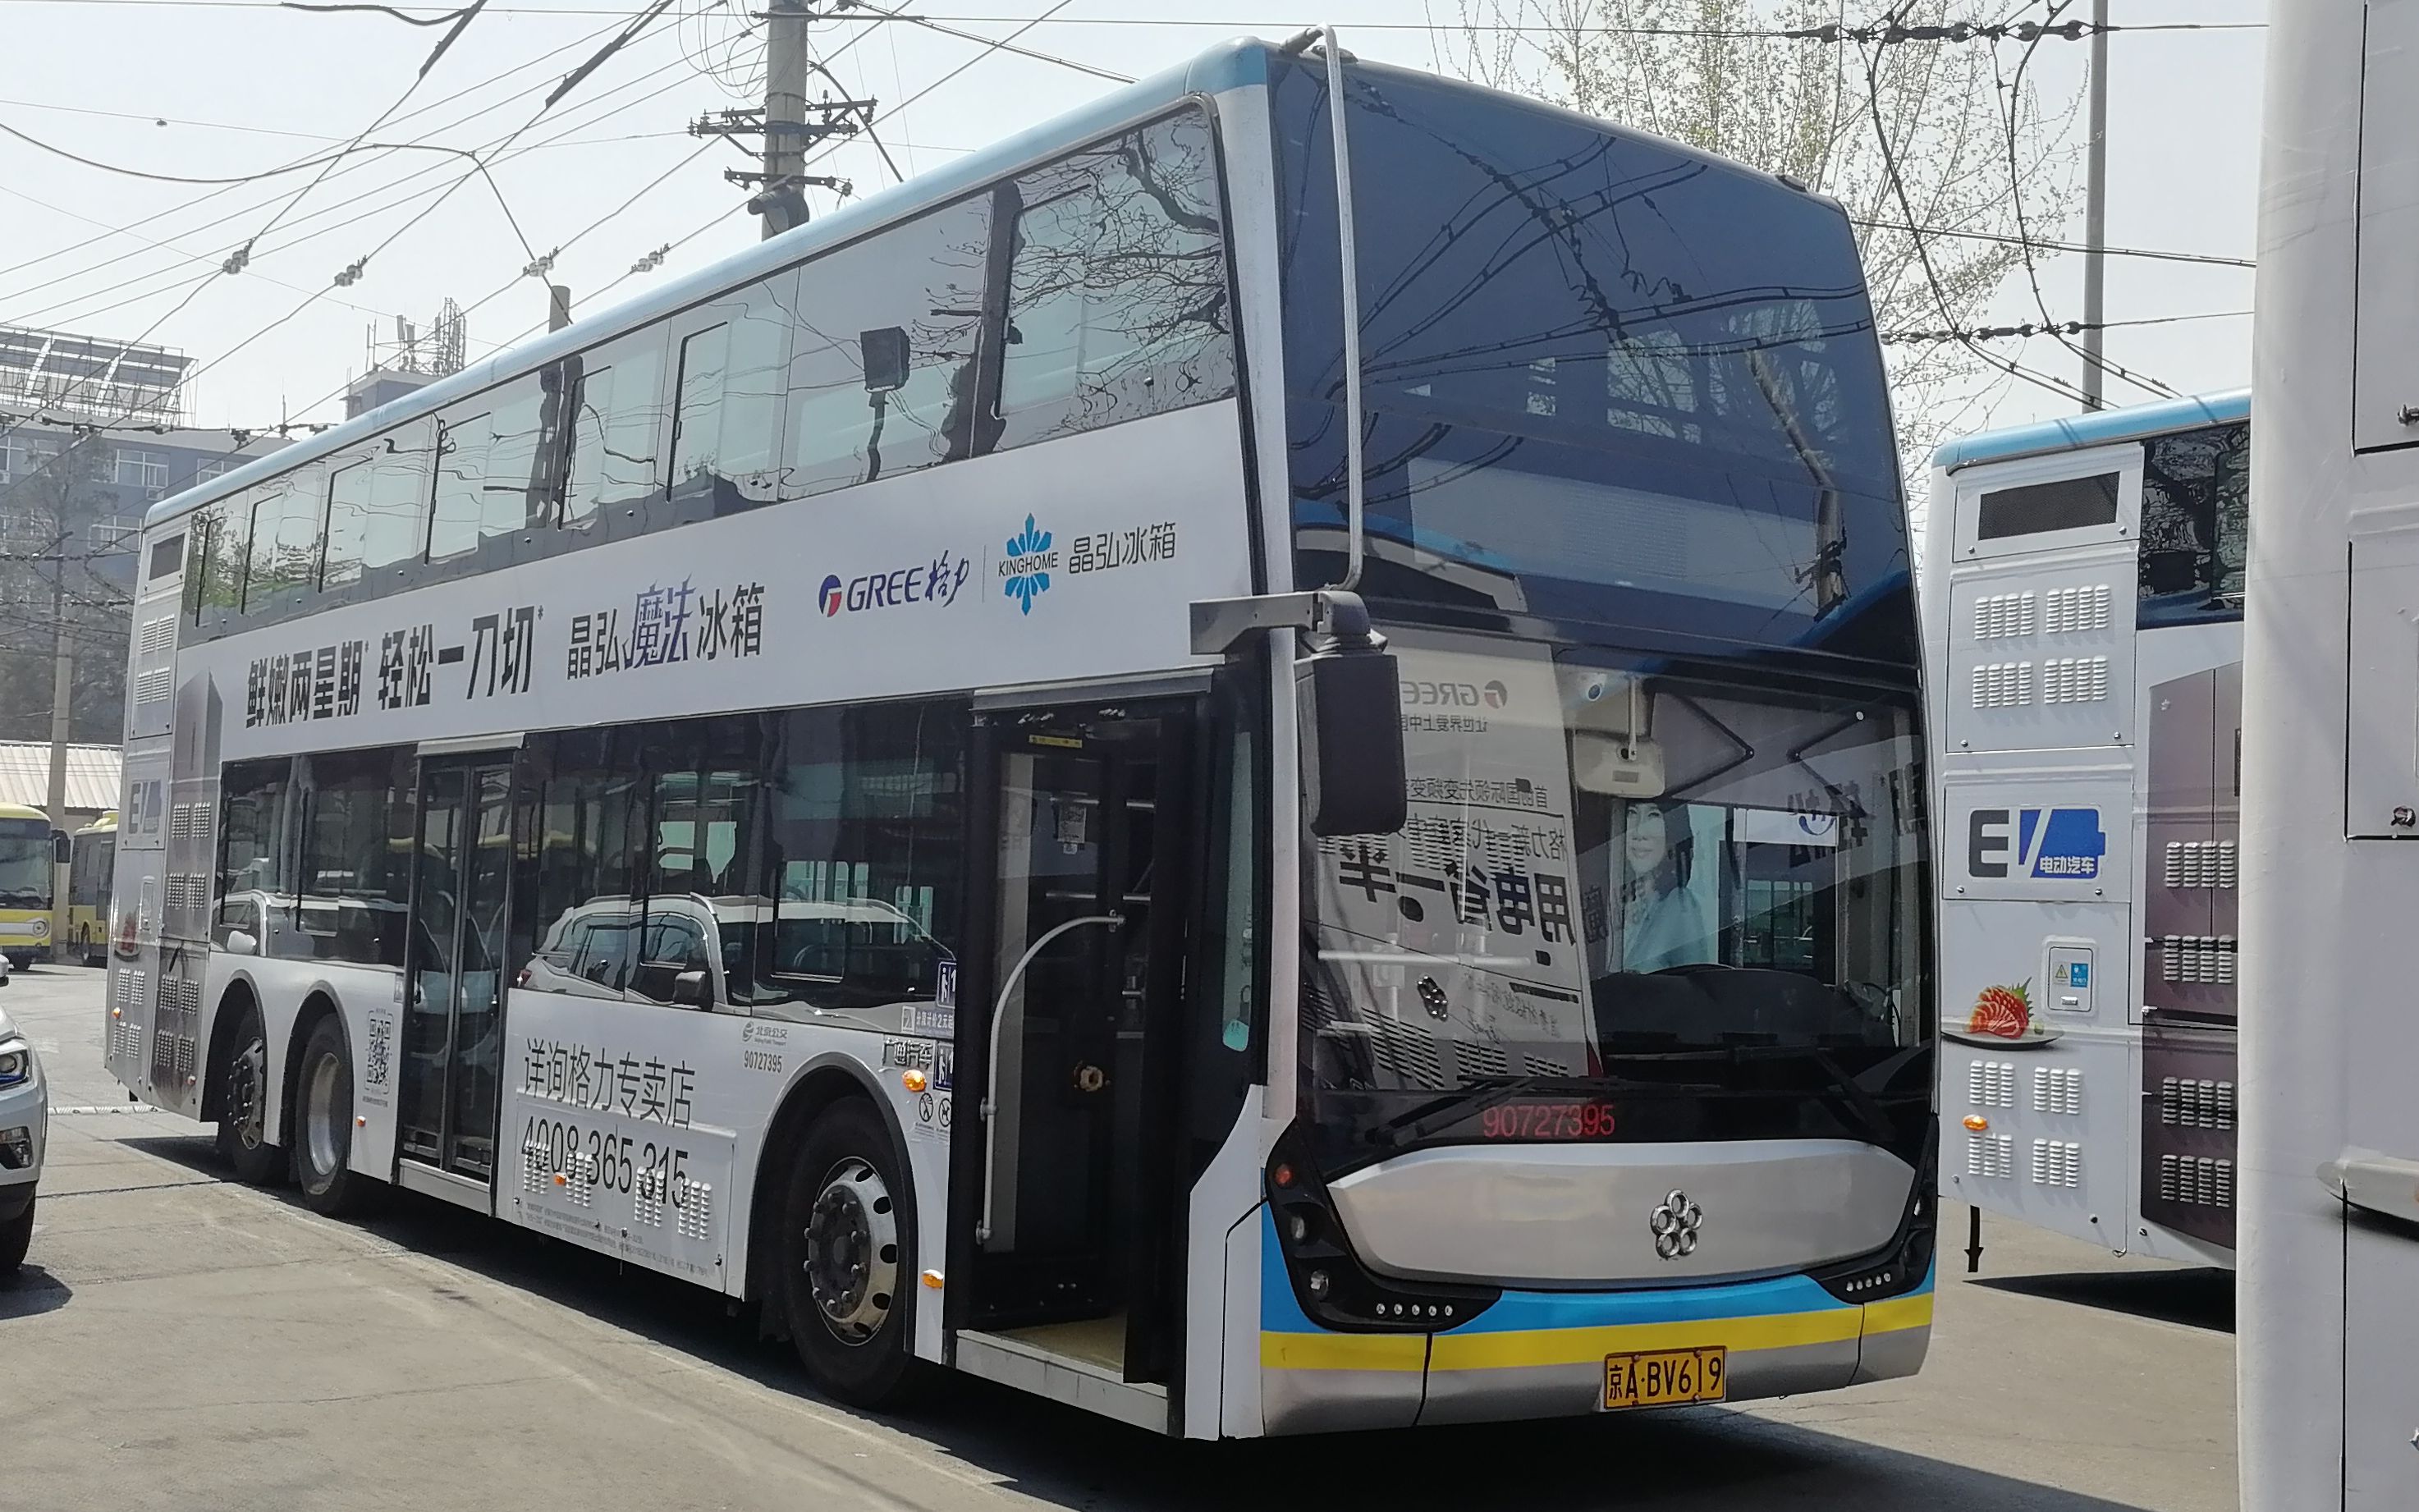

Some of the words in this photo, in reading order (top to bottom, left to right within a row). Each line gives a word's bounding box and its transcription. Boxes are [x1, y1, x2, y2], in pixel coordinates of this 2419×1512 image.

[998, 552, 1059, 577] KINGHOME
[1069, 521, 1175, 573] 晶弘冰箱
[847, 567, 924, 612] GREE
[567, 572, 764, 680] 晶弘魔法冰箱
[2040, 856, 2096, 874] 电动汽车
[755, 1025, 788, 1039] 北京公交
[744, 1050, 782, 1074] 90727395
[525, 1038, 695, 1131] 详询格力专卖店
[1483, 1104, 1615, 1138] 90727395
[587, 1129, 634, 1194] 365
